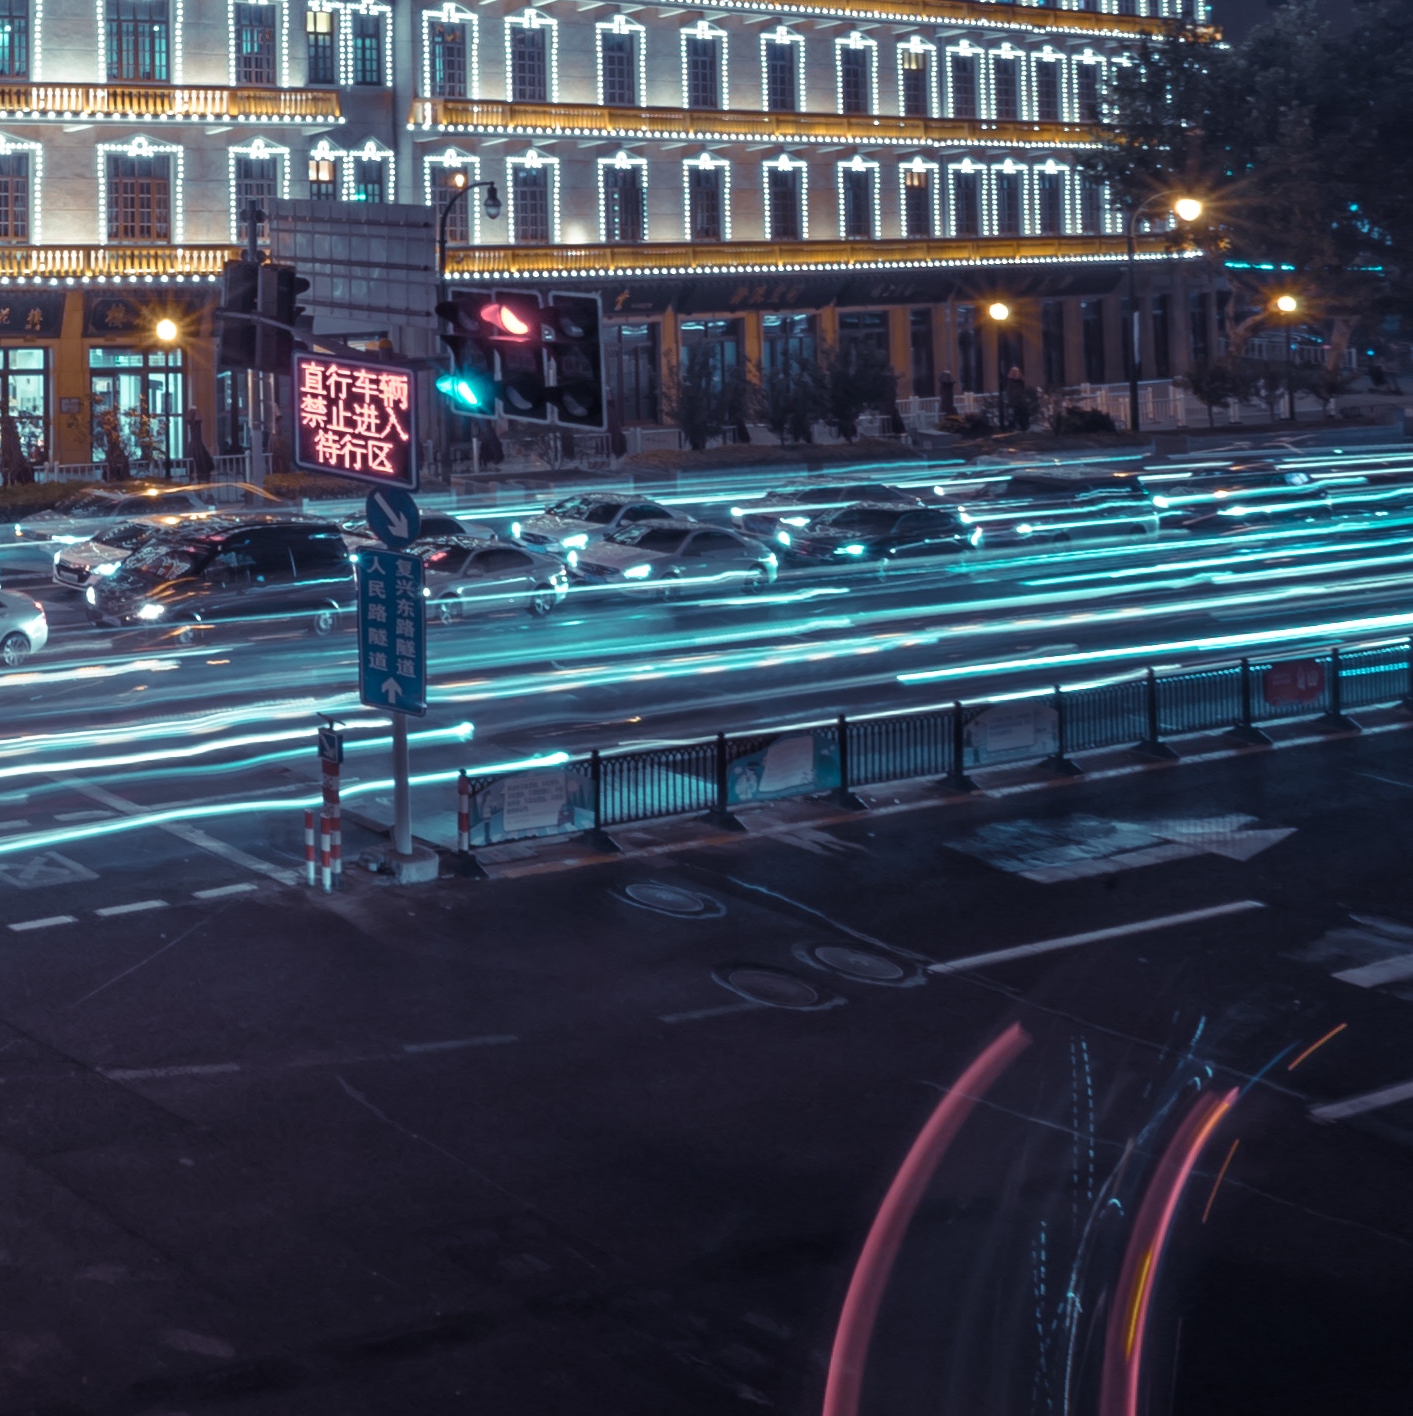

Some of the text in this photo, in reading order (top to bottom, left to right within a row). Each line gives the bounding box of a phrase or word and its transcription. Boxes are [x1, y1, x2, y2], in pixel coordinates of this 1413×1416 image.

[300, 362, 408, 411] 直行车辆
[300, 394, 409, 441] 禁止进入
[314, 429, 394, 473] 待行区
[367, 556, 388, 672] 人民路隧道
[395, 559, 417, 679] 复兴东路隧道
